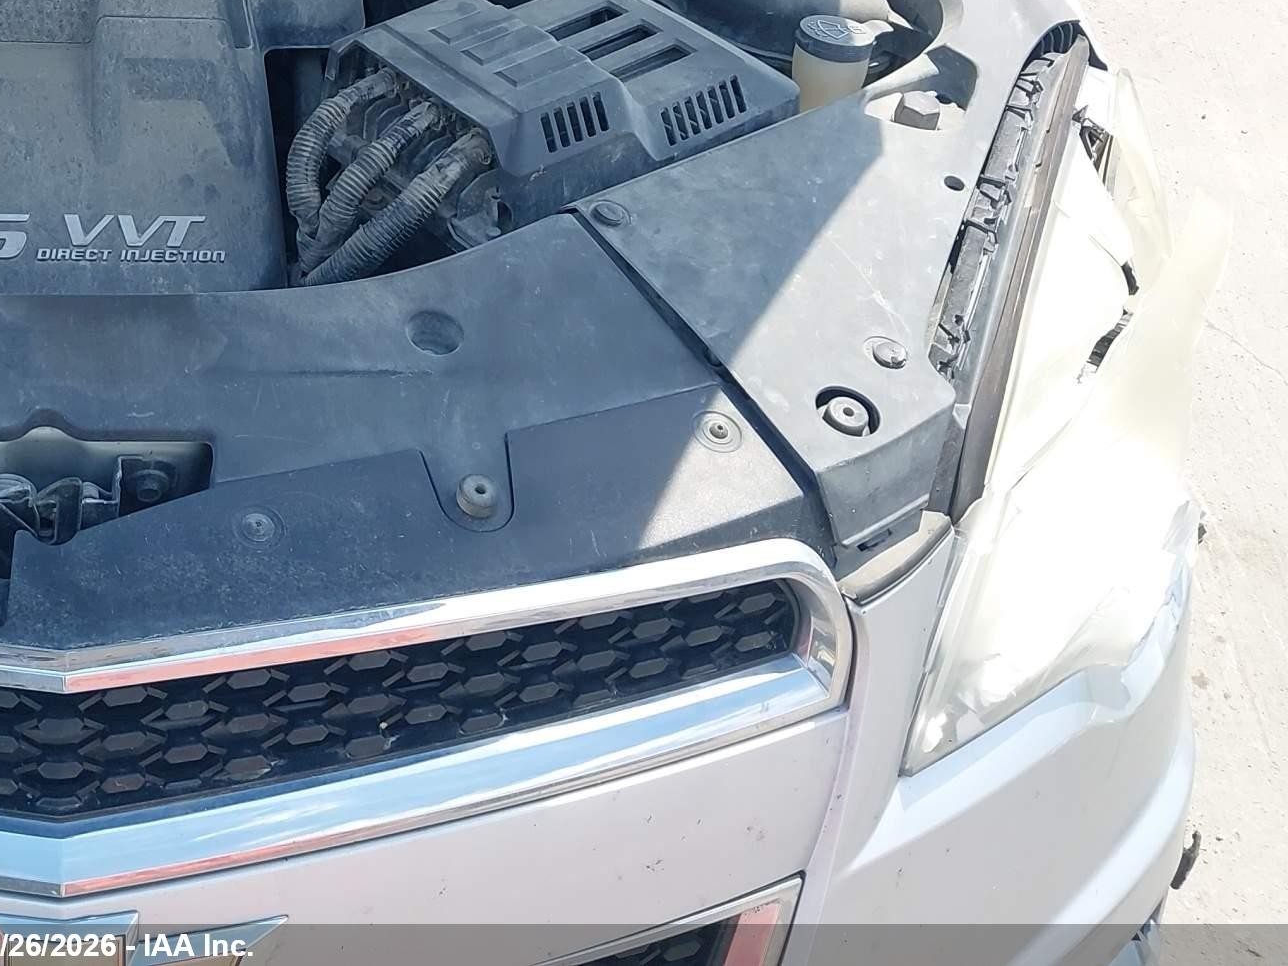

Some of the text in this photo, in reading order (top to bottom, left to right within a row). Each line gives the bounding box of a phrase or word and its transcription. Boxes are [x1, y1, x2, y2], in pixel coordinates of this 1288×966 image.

[63, 213, 207, 247] VVT
[36, 248, 227, 263] DIRECT INJECTION
